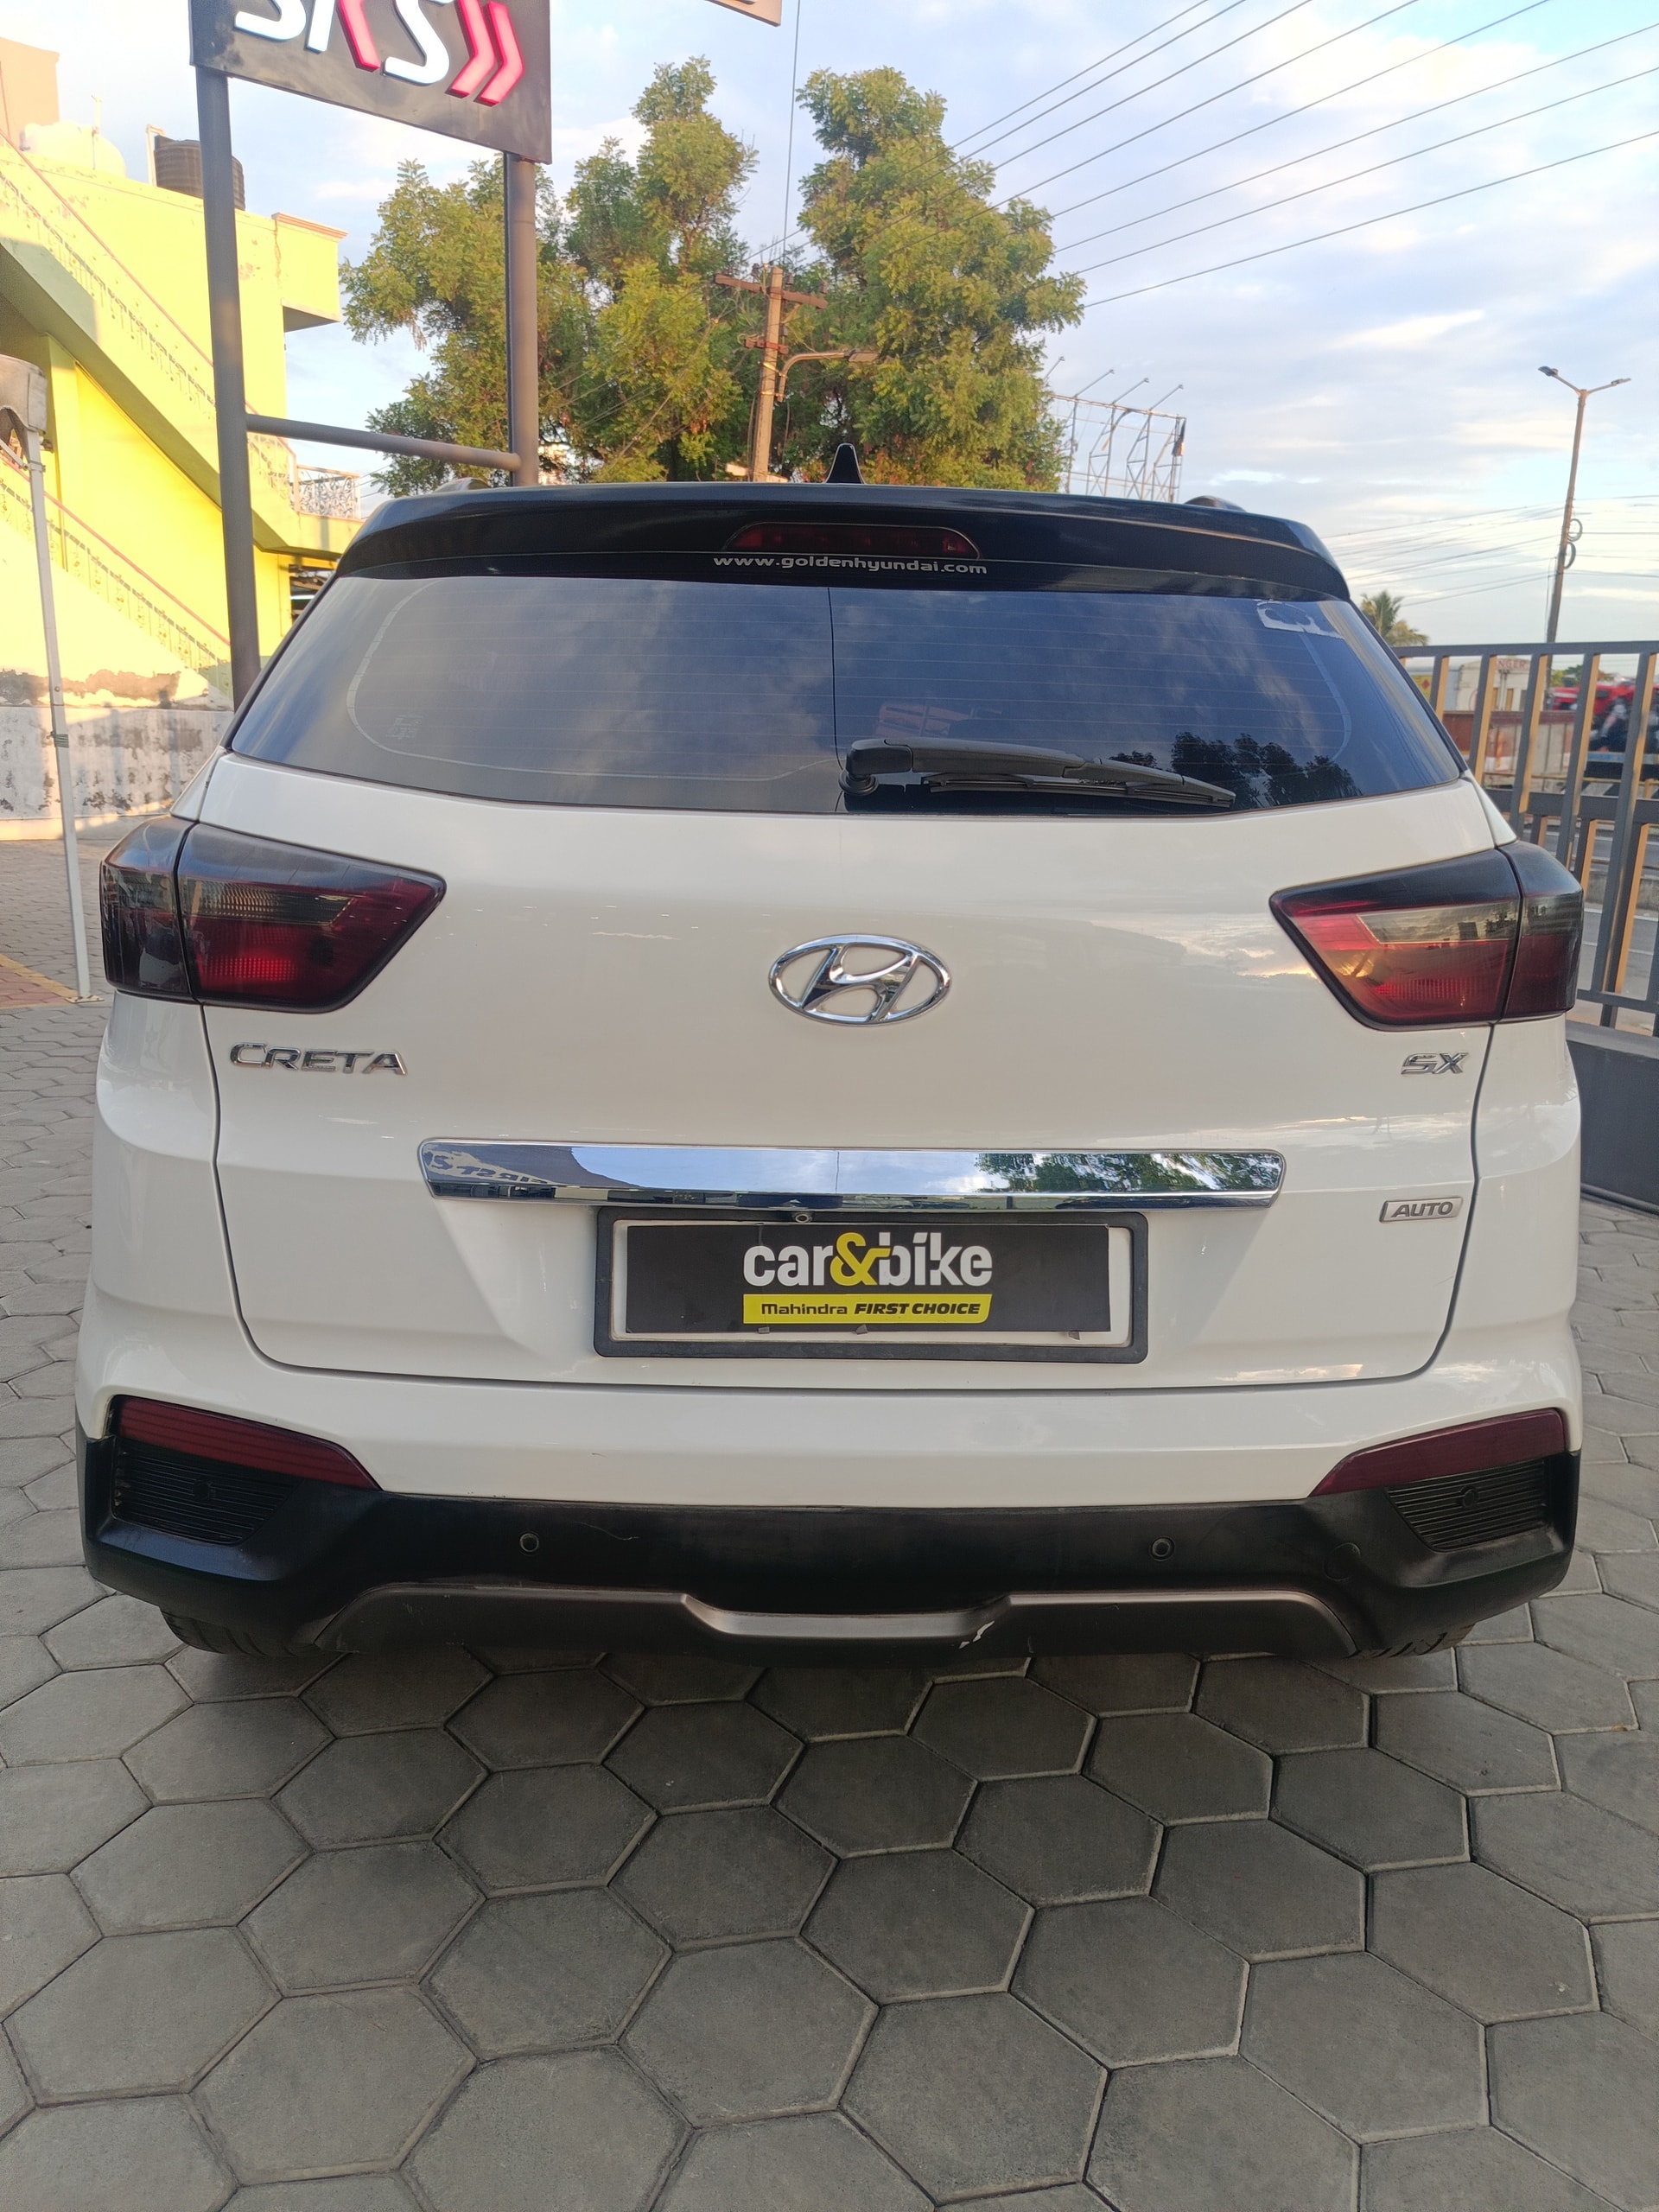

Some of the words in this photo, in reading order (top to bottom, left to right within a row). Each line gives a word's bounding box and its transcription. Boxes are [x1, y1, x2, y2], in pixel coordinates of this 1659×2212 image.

[713, 556, 988, 574] www.goldenhyundai.com
[230, 1042, 408, 1076] CRETA
[1401, 1052, 1469, 1075] SX
[1390, 1201, 1453, 1217] AUTO
[761, 1303, 848, 1315] Mahindra
[854, 1302, 909, 1315] FIRST
[912, 1303, 981, 1315] CHOICE
